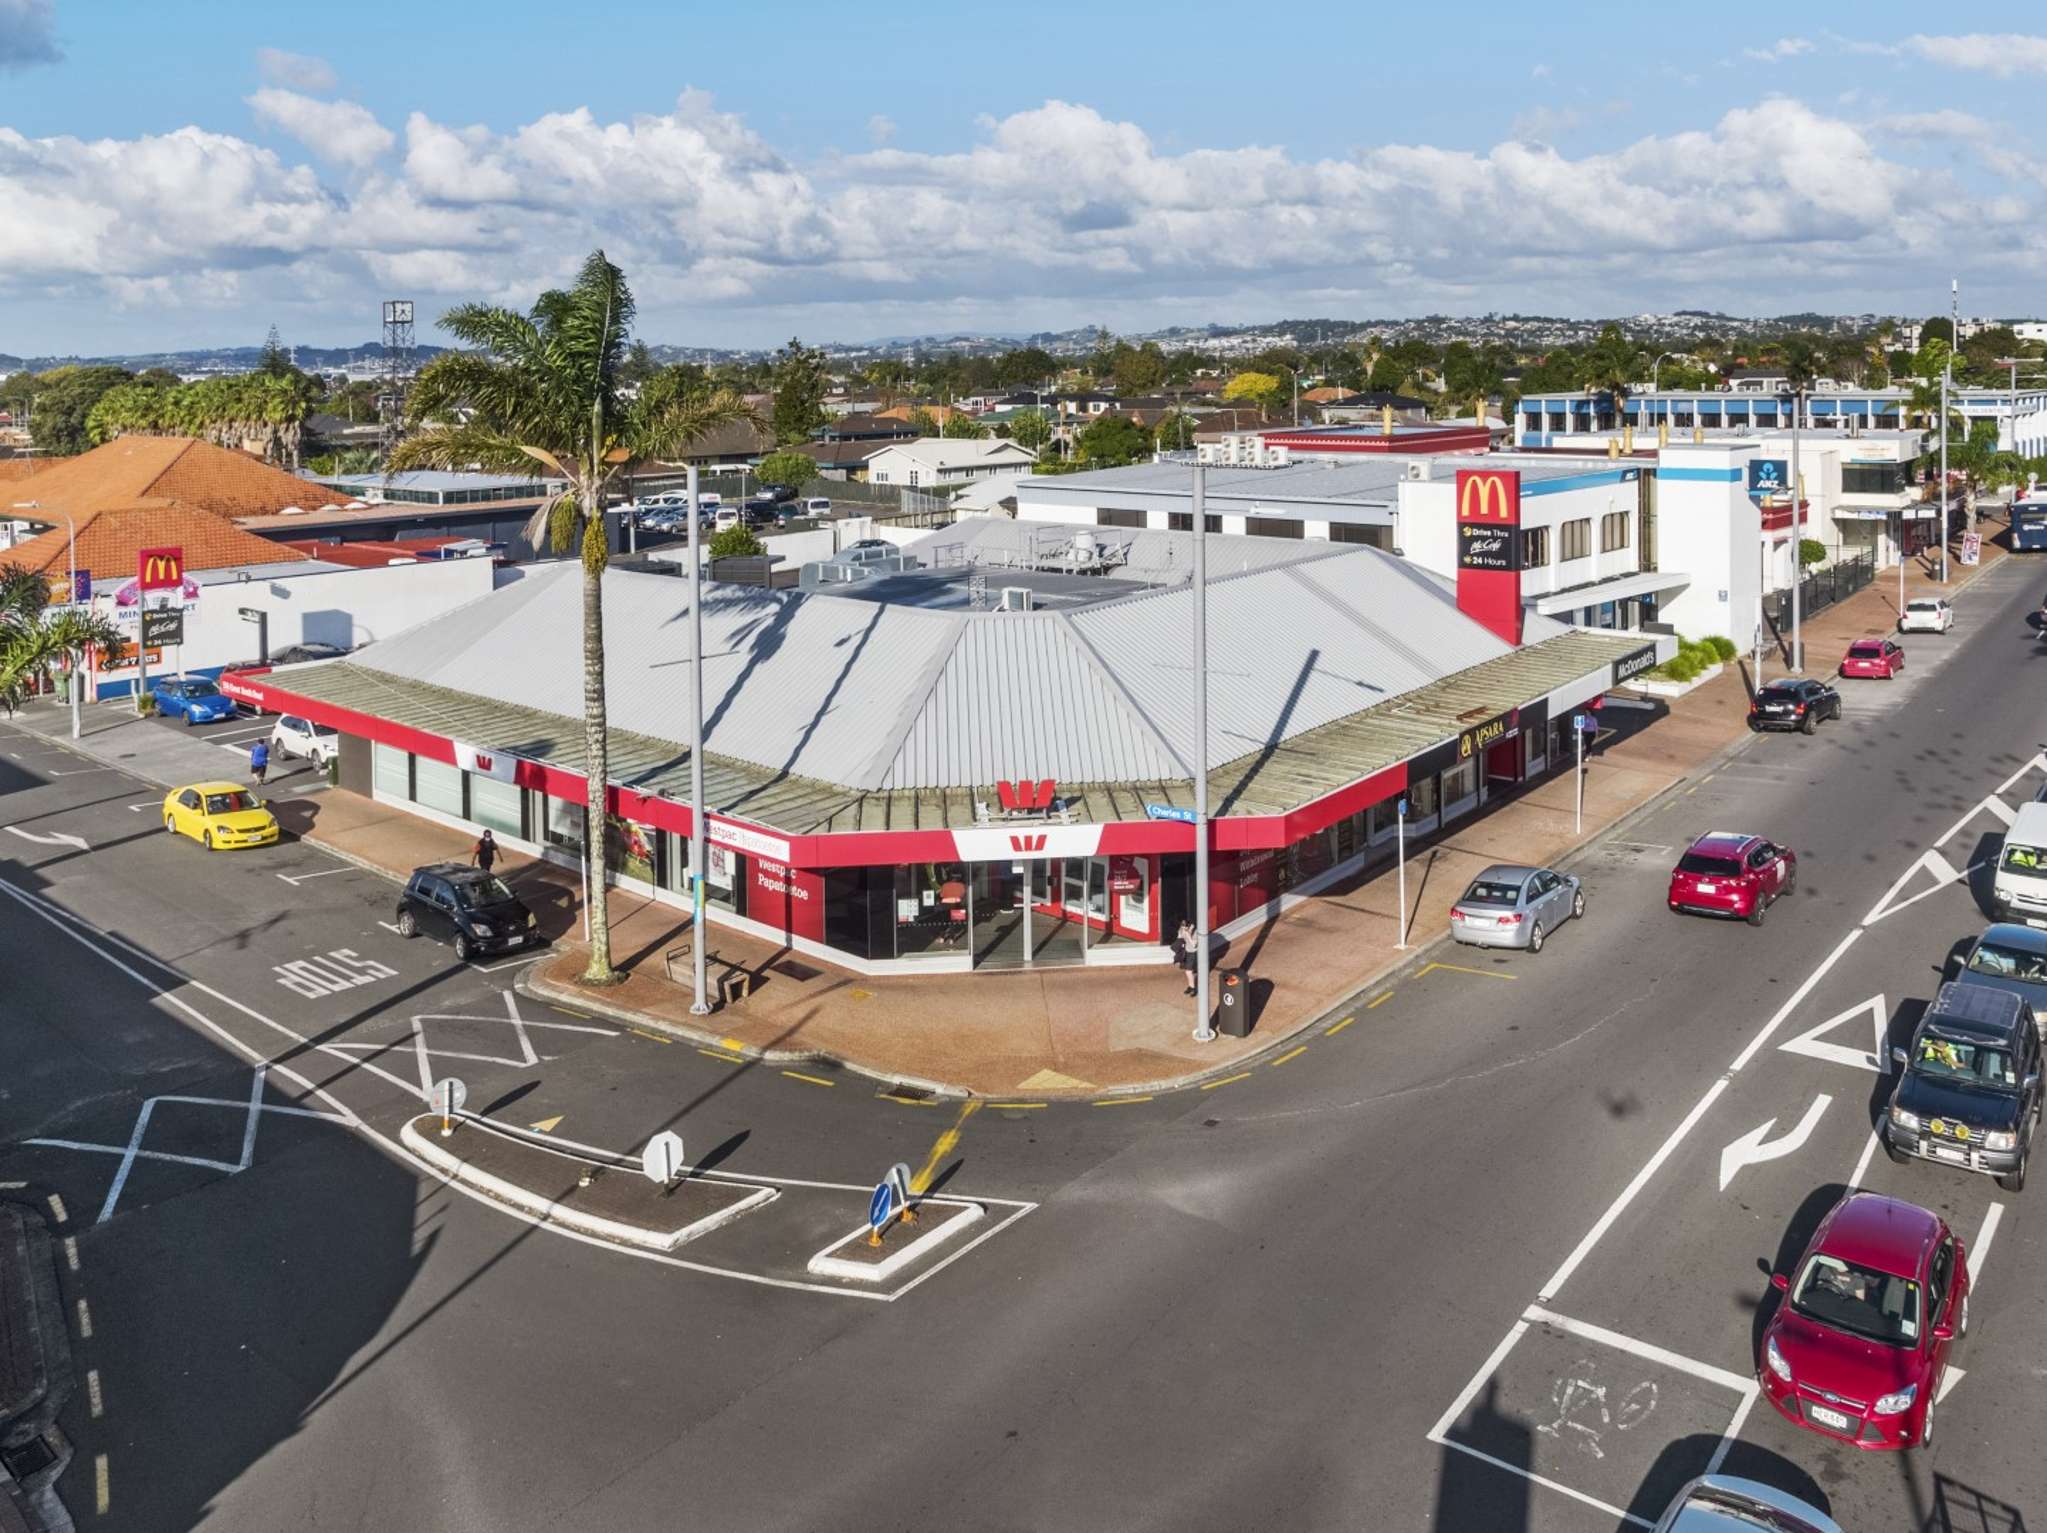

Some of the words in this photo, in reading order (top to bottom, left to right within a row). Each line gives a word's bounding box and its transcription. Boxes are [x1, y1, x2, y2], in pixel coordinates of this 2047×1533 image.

[1756, 480, 1780, 489] ANZ
[1472, 528, 1492, 536] Drive
[1493, 529, 1509, 537] Thru
[1472, 556, 1482, 565] 24
[1484, 557, 1507, 566] Hours
[1617, 651, 1655, 680] McDonald's
[1475, 721, 1504, 749] APSARA
[1152, 806, 1181, 819] Charles
[1183, 810, 1193, 820] St
